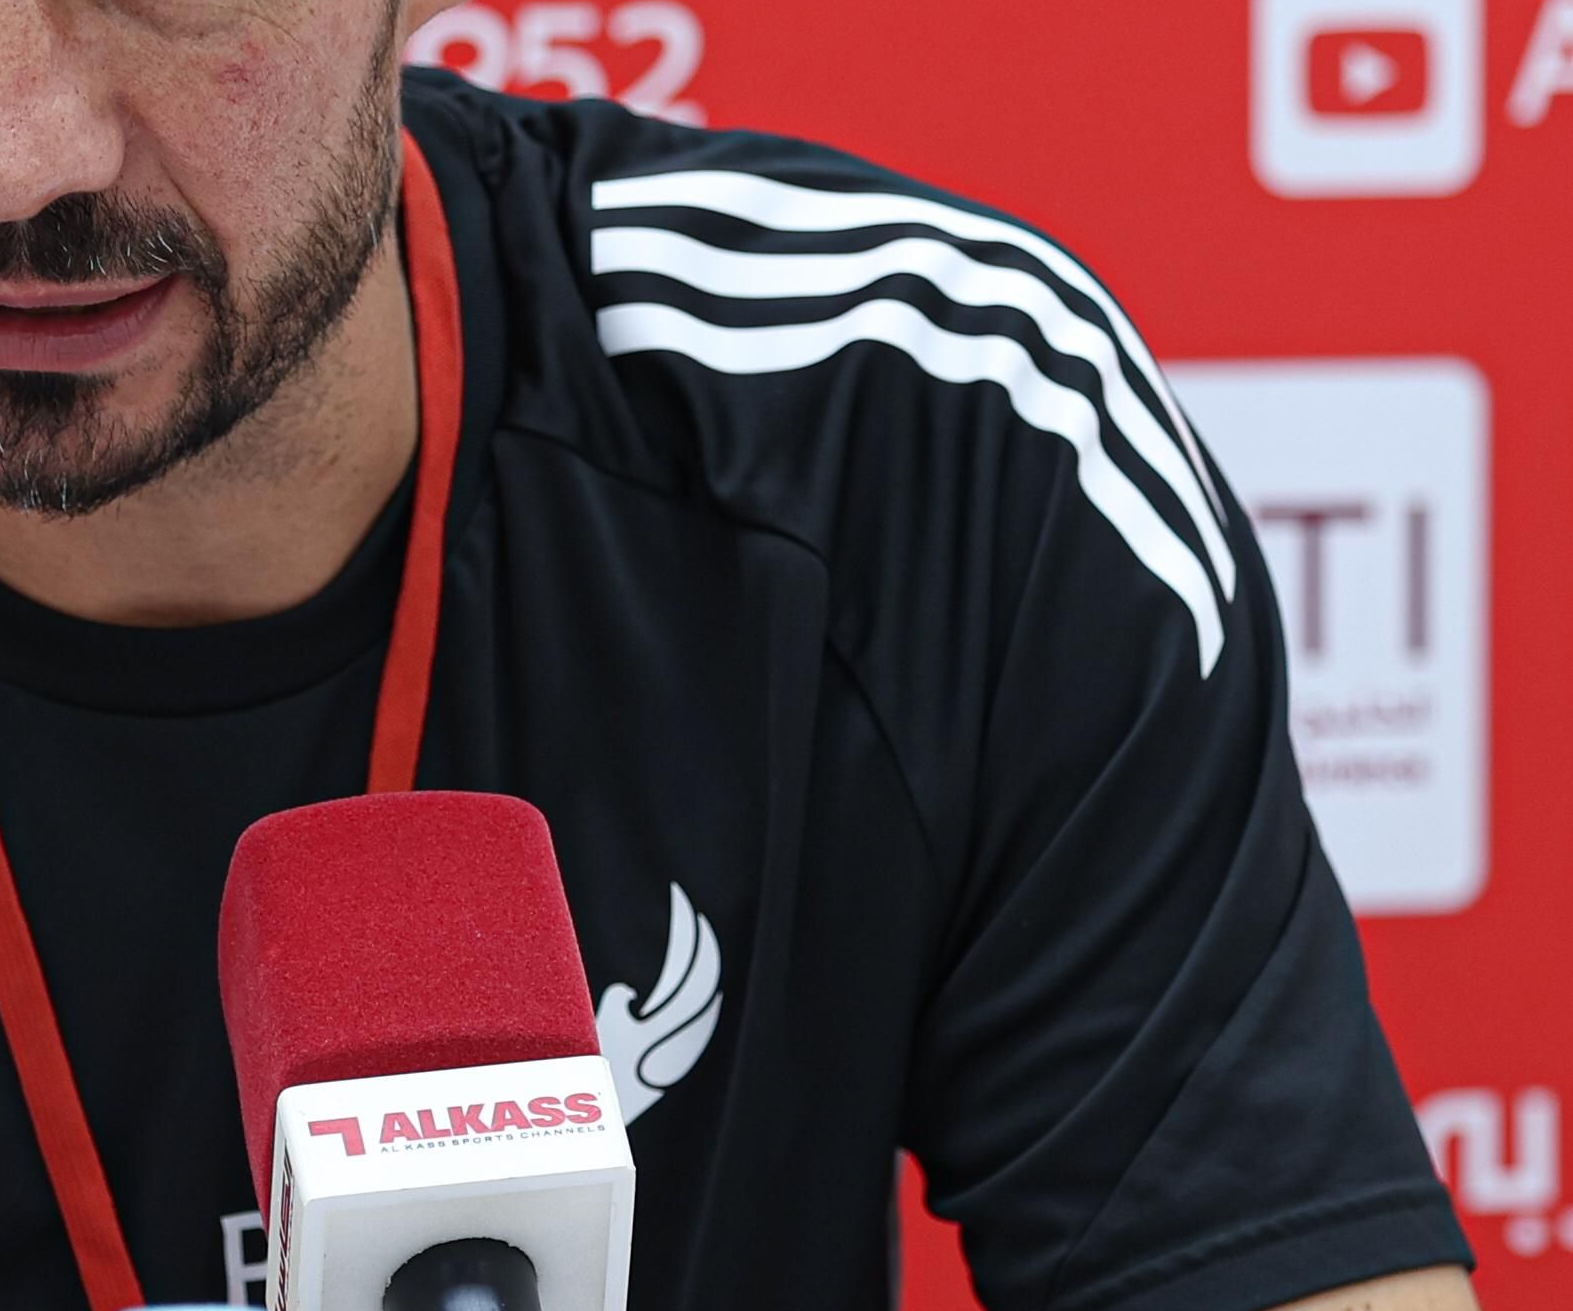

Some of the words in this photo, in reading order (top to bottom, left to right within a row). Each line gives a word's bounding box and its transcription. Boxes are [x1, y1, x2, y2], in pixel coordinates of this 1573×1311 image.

[379, 1093, 602, 1144] ALKASS
[380, 1146, 400, 1154] AL
[405, 1140, 446, 1151] KASS
[452, 1133, 515, 1147] SPORTS
[520, 1124, 606, 1140] CHANNELS
